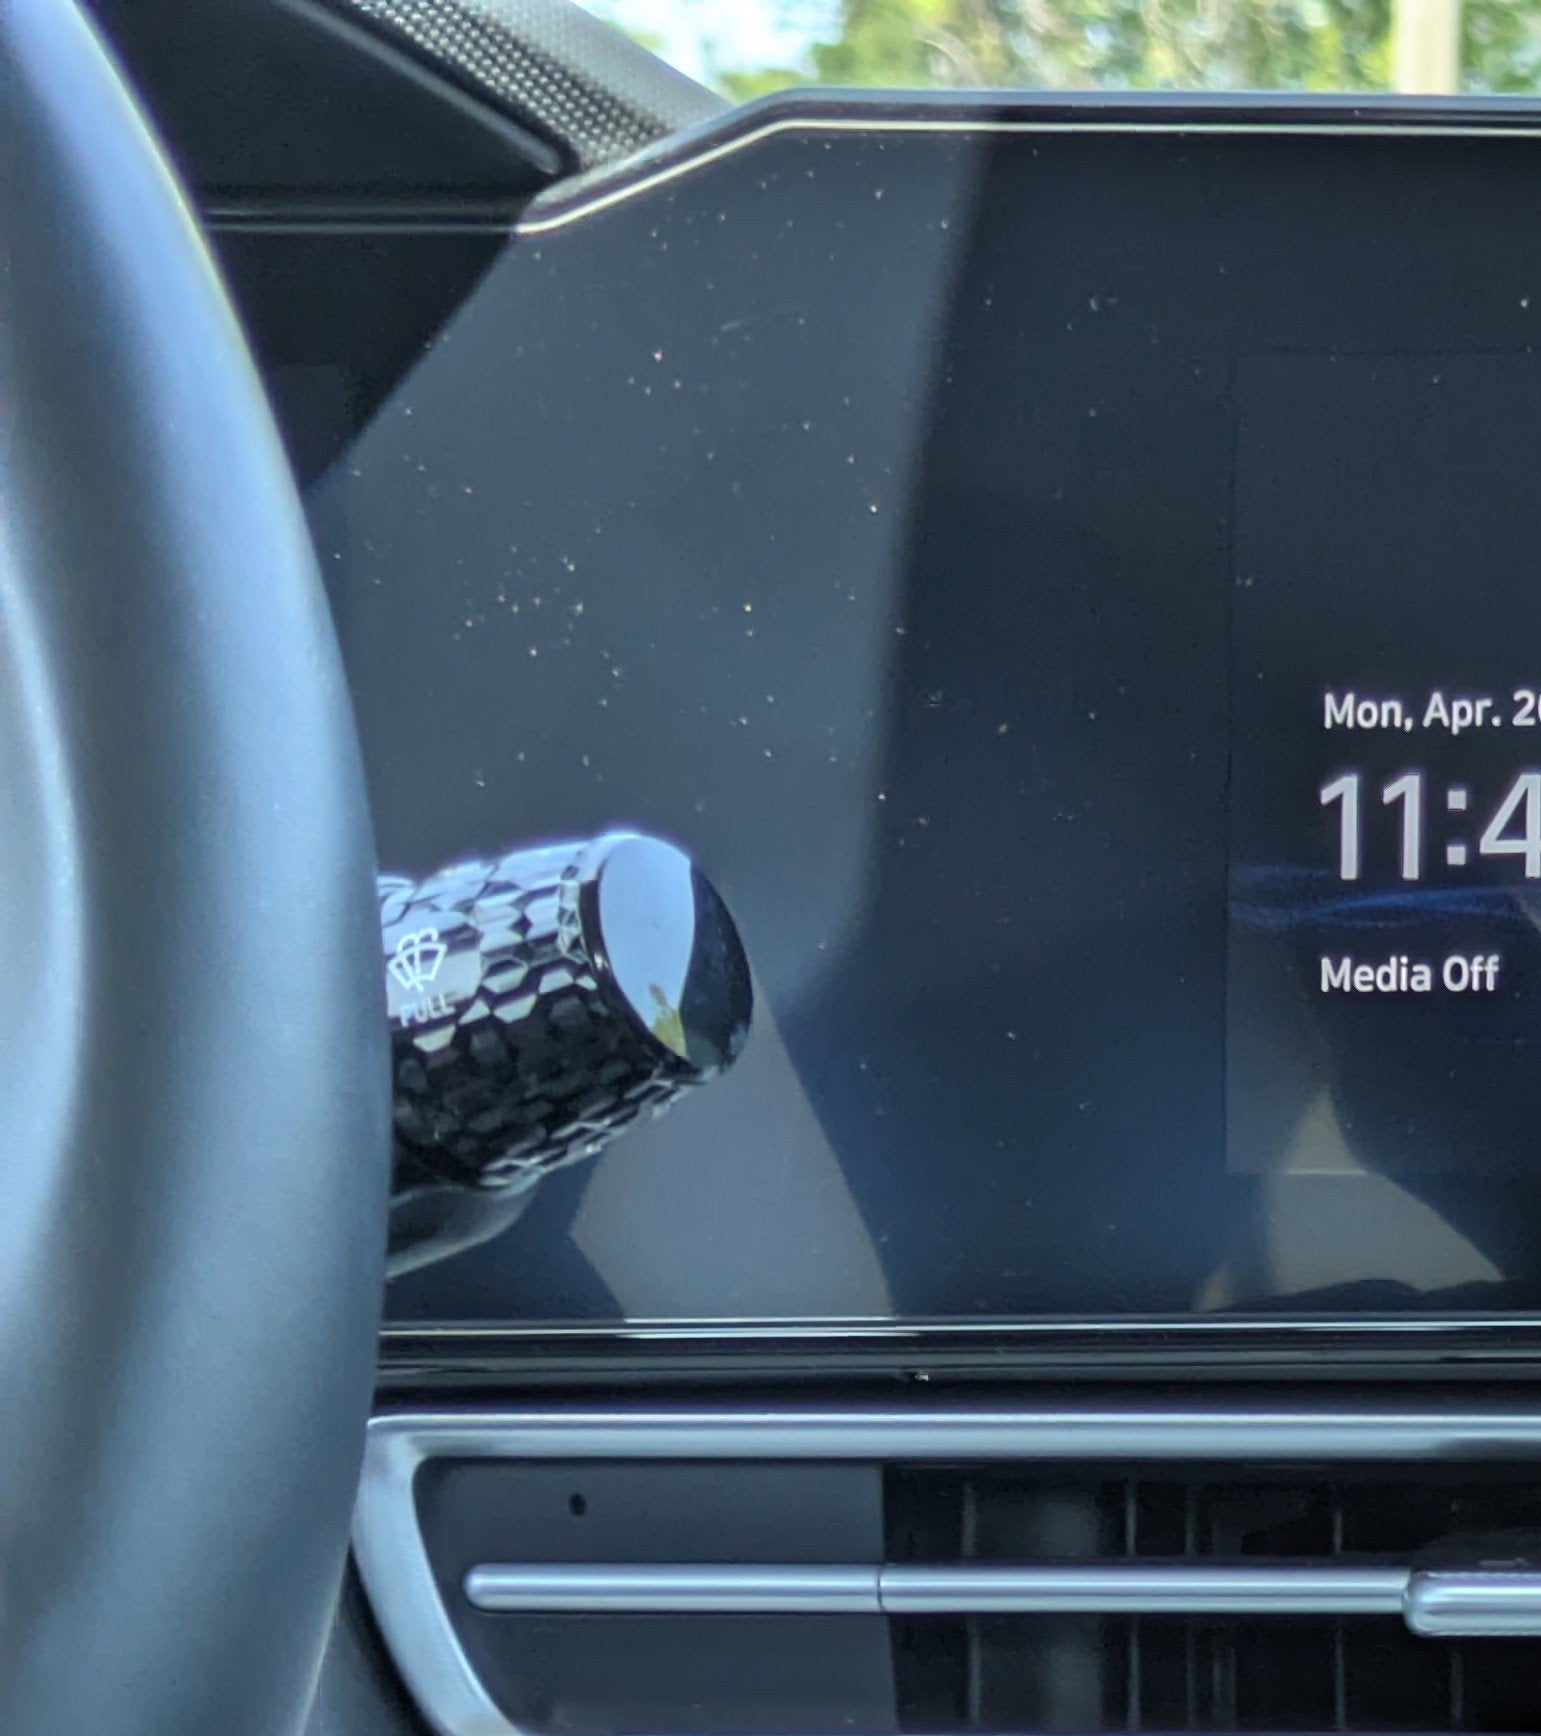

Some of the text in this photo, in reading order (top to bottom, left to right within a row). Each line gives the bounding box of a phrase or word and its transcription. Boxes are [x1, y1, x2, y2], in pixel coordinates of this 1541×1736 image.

[1322, 692, 1414, 733] Mon,
[1421, 692, 1502, 736] Apr.
[1319, 954, 1501, 993] Media Off
[400, 994, 456, 1028] PULL
